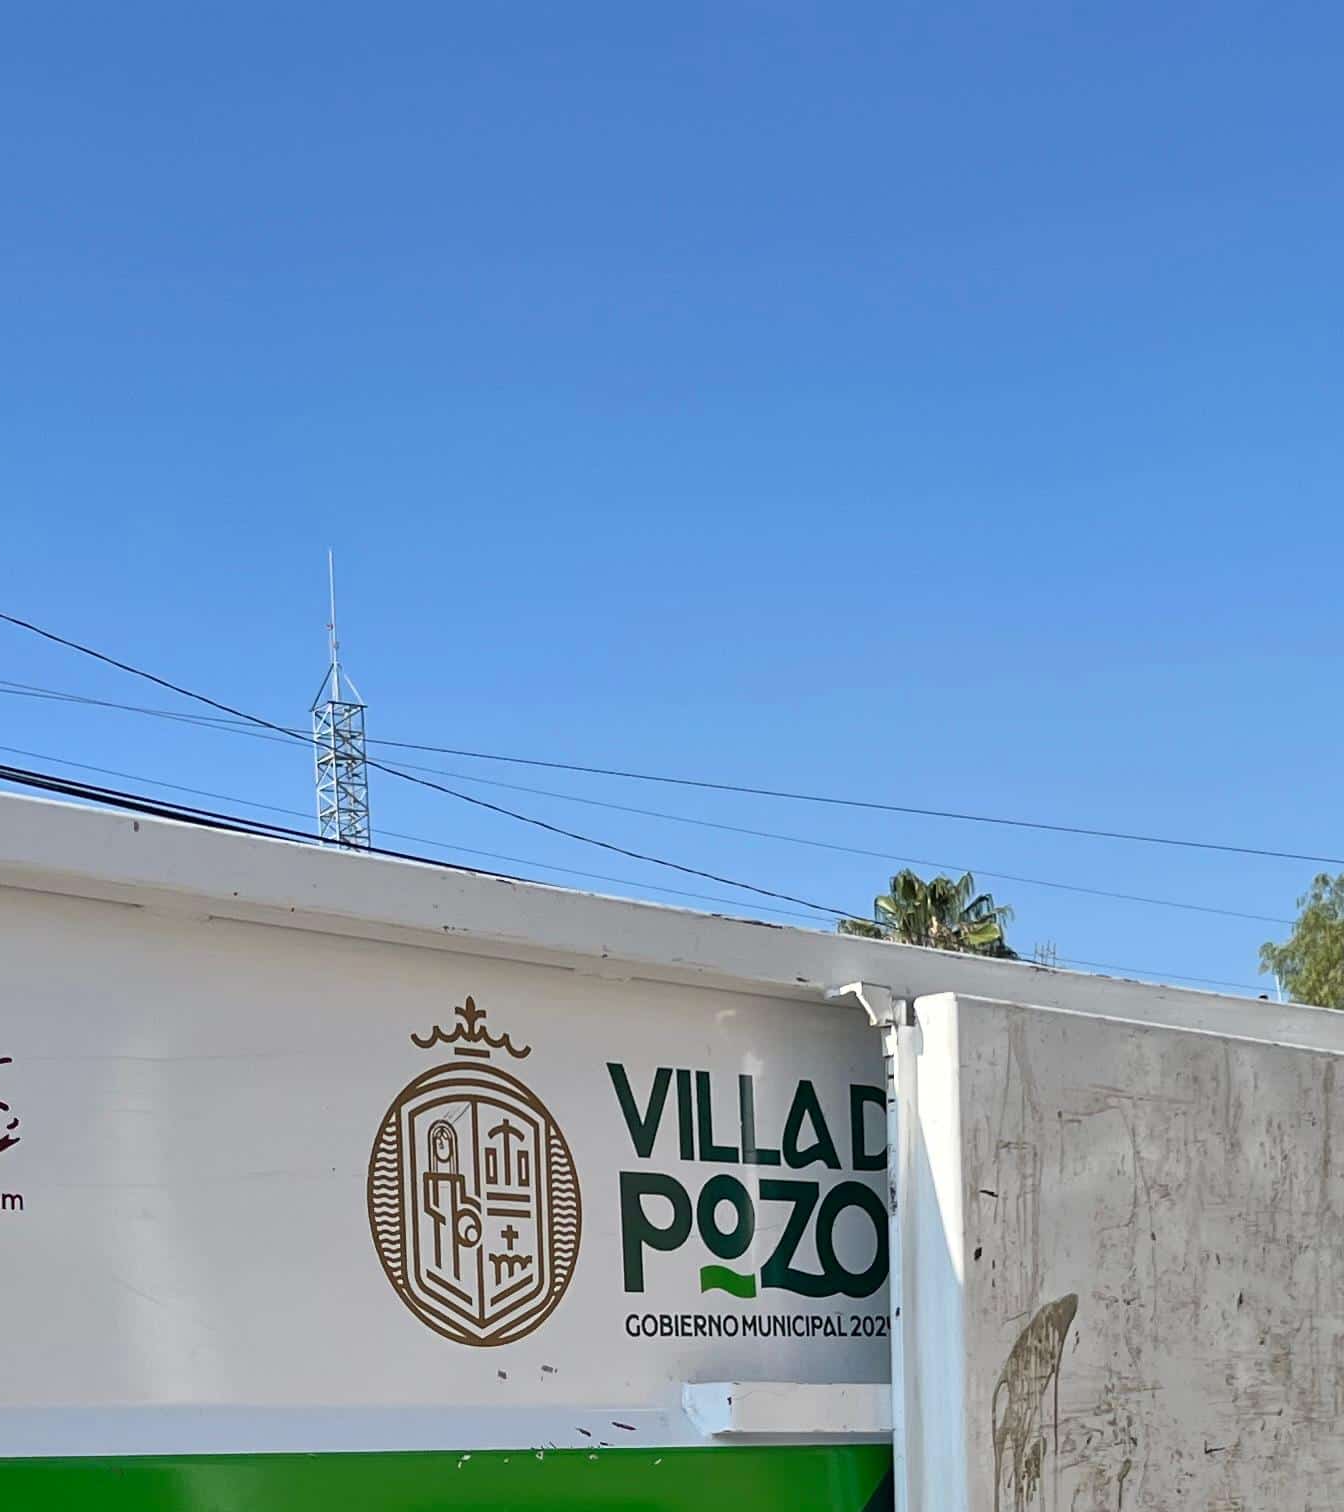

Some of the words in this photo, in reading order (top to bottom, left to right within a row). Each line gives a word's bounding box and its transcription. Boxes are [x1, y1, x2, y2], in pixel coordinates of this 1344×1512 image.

[606, 1062, 841, 1169] VILLA
[850, 1084, 887, 1171] D
[620, 1171, 890, 1298] POZO
[625, 1313, 739, 1337] GOBIERNO
[742, 1314, 847, 1337] MUNICIPAL
[850, 1315, 891, 1337] 202
